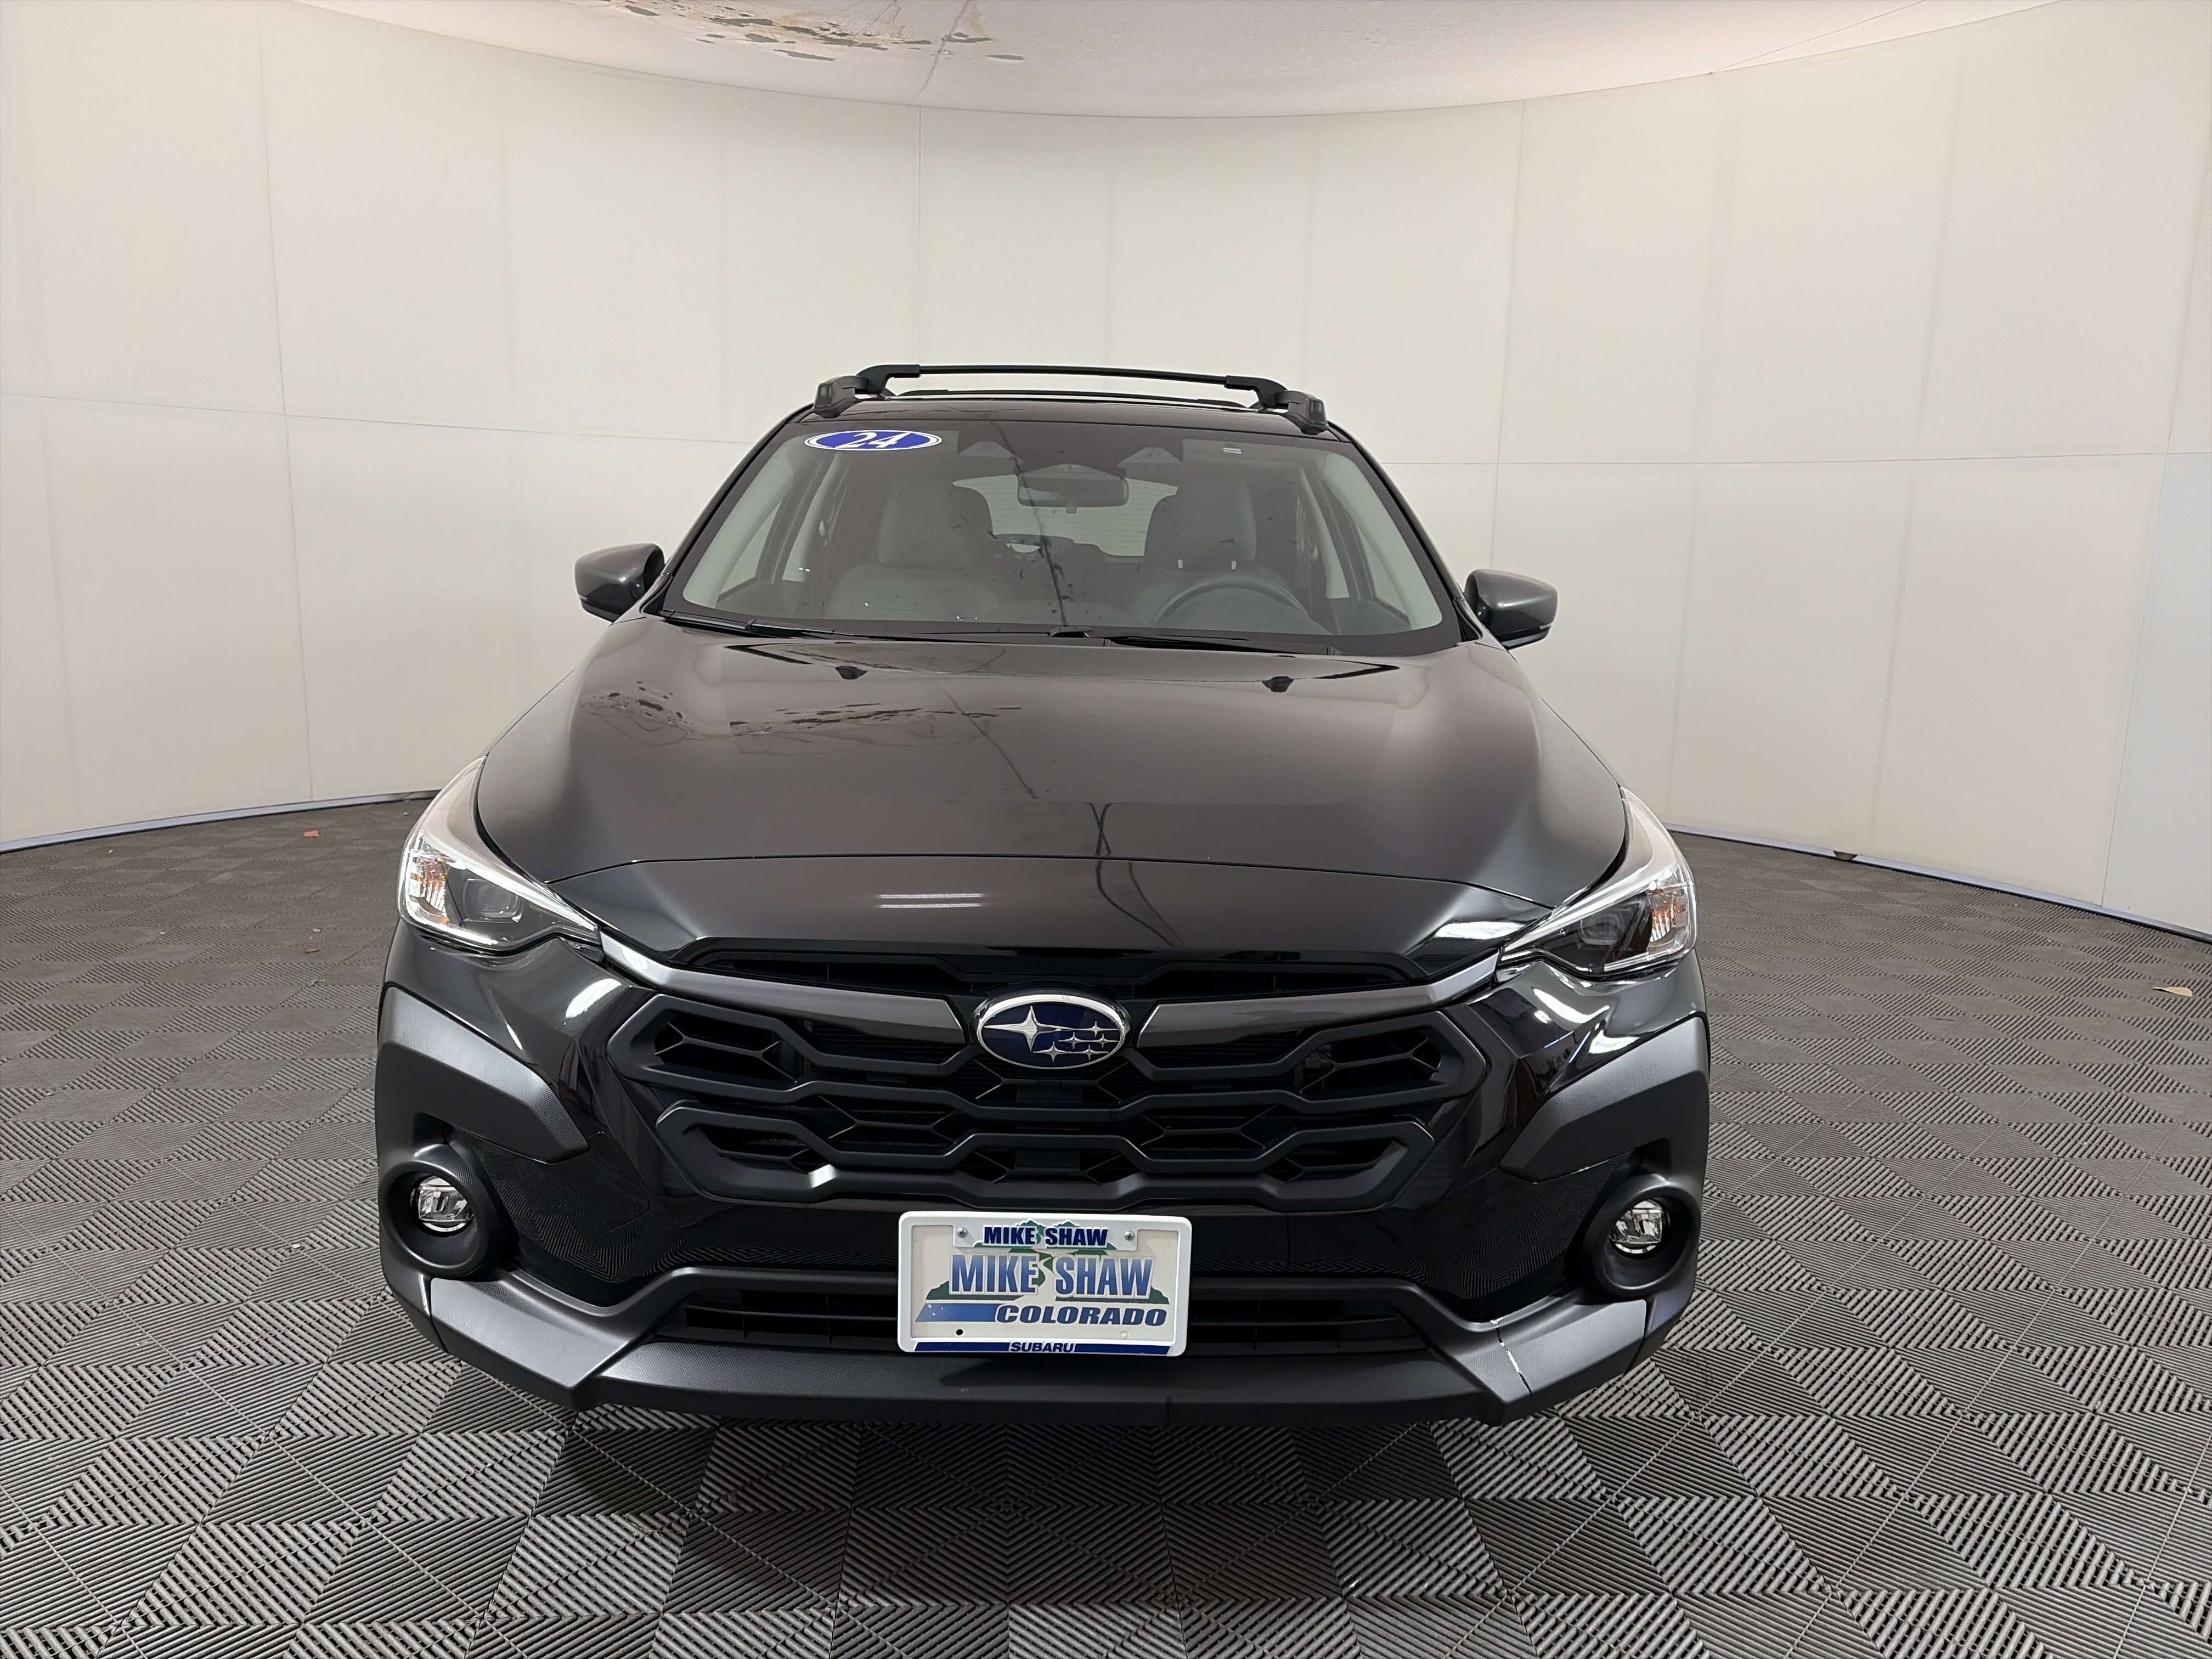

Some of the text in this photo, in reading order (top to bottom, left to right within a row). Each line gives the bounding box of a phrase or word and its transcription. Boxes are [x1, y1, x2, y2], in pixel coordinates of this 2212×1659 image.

[834, 431, 911, 449] 24
[984, 1226, 1109, 1246] MIKE SHAW
[952, 1254, 1153, 1296] MIKE SHAW
[996, 1305, 1167, 1327] COLORADO
[1010, 1341, 1075, 1353] SUBARU
